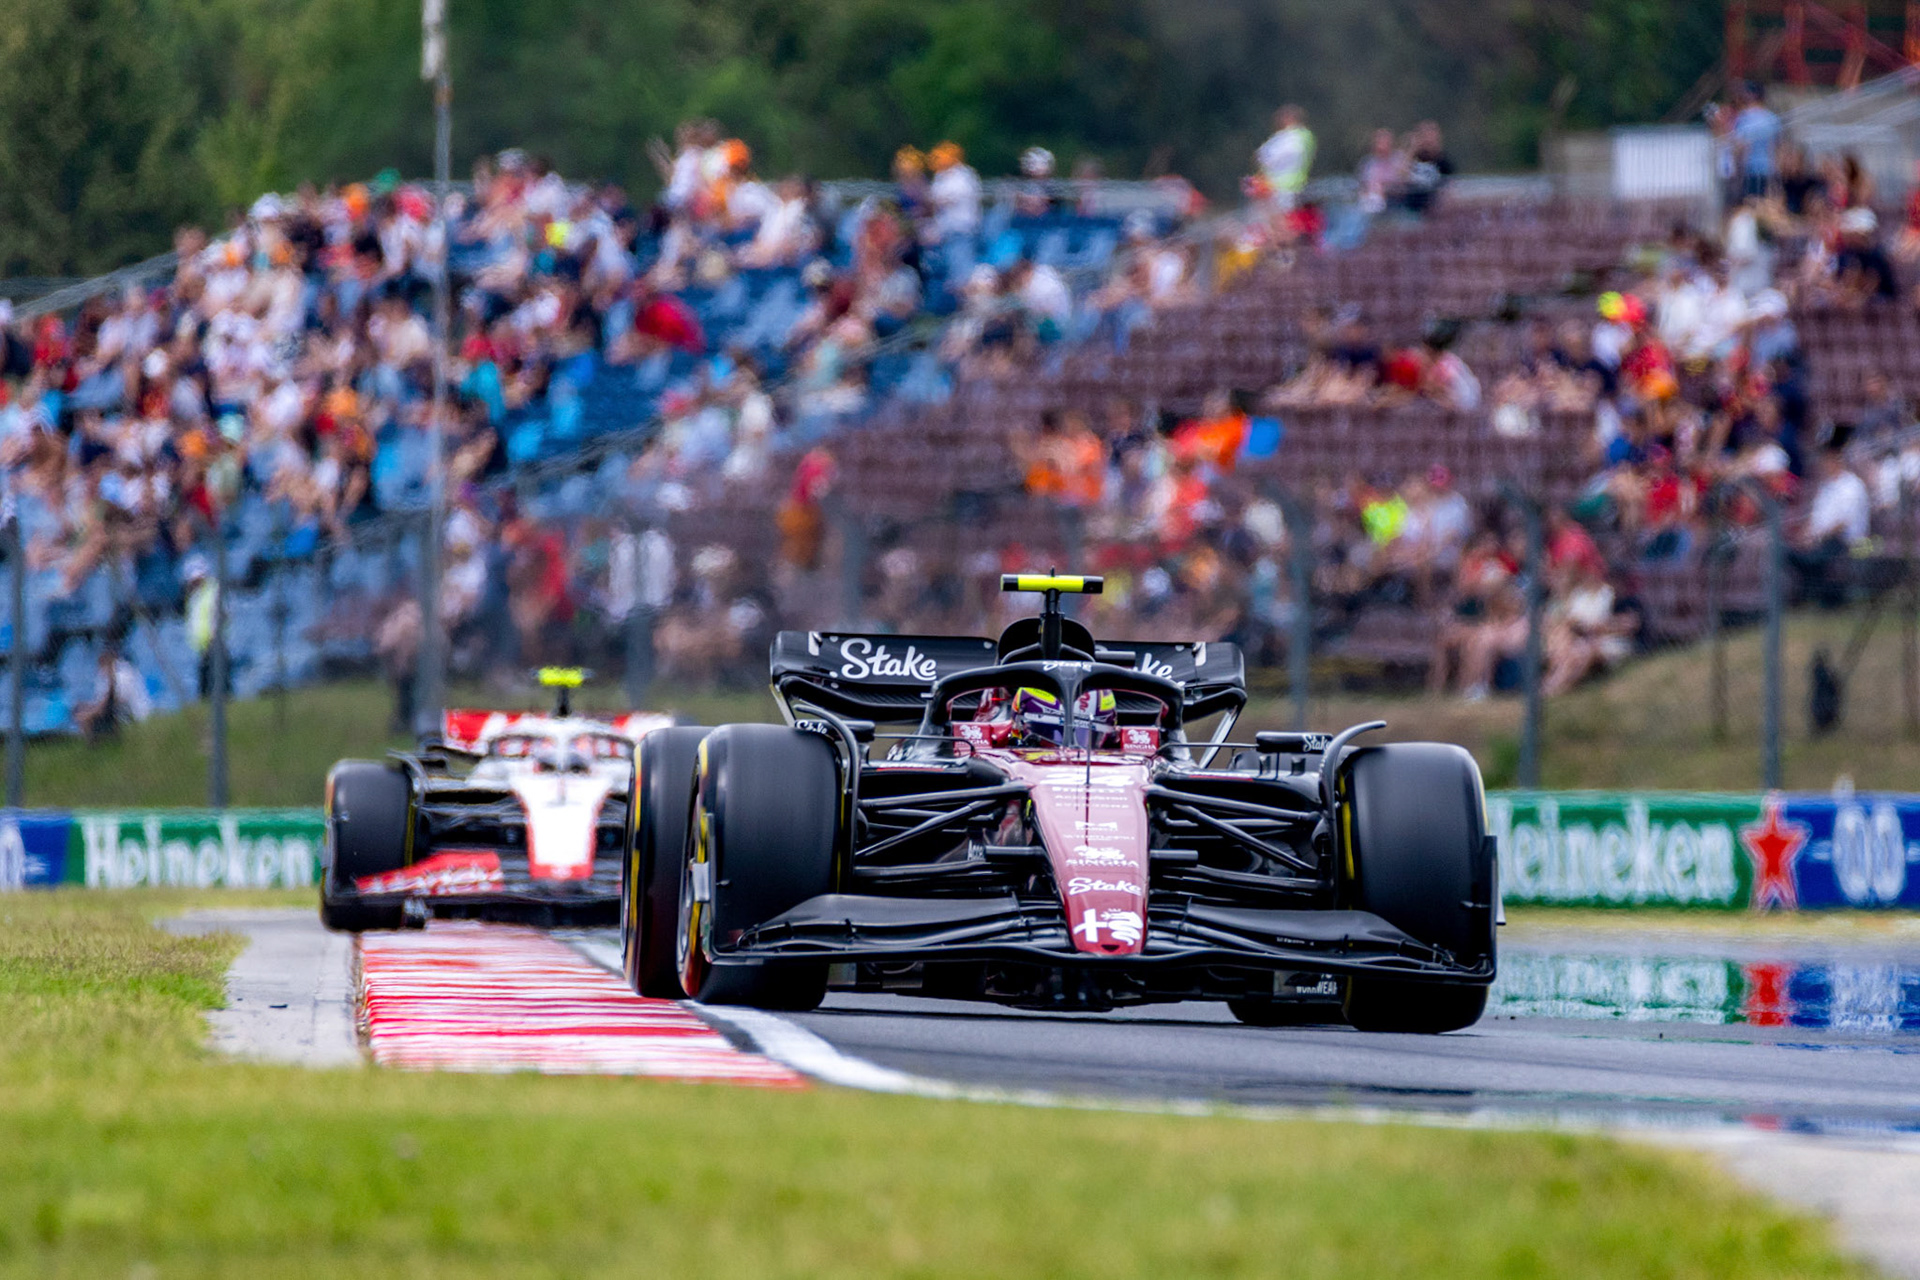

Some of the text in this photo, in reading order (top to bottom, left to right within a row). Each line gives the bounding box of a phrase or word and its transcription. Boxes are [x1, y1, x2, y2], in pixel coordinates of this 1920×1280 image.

[840, 637, 937, 681] Stake
[80, 810, 314, 890] Heineken
[1065, 858, 1140, 868] SINGHA
[1067, 877, 1142, 896] Stake
